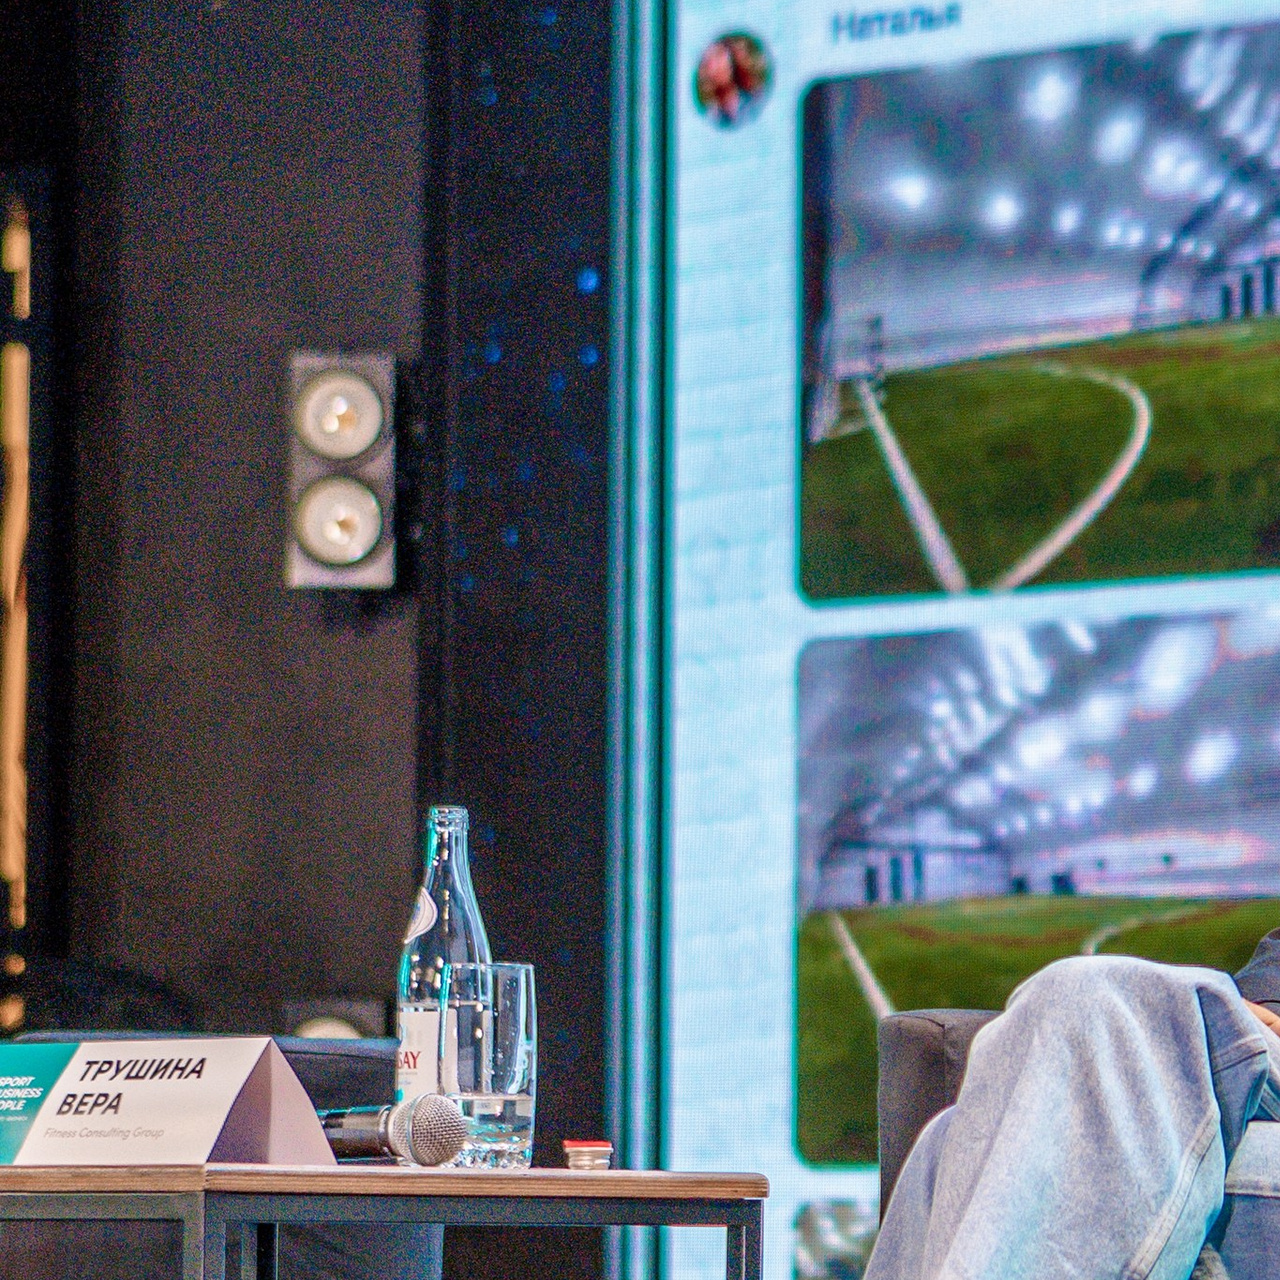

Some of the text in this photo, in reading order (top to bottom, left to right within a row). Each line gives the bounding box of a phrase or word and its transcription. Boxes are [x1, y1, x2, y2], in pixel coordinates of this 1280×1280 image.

[79, 1057, 207, 1082] ТРУШИНА
[56, 1092, 123, 1116] ВЕРА
[44, 1127, 165, 1141] Fitness Consulting Group
